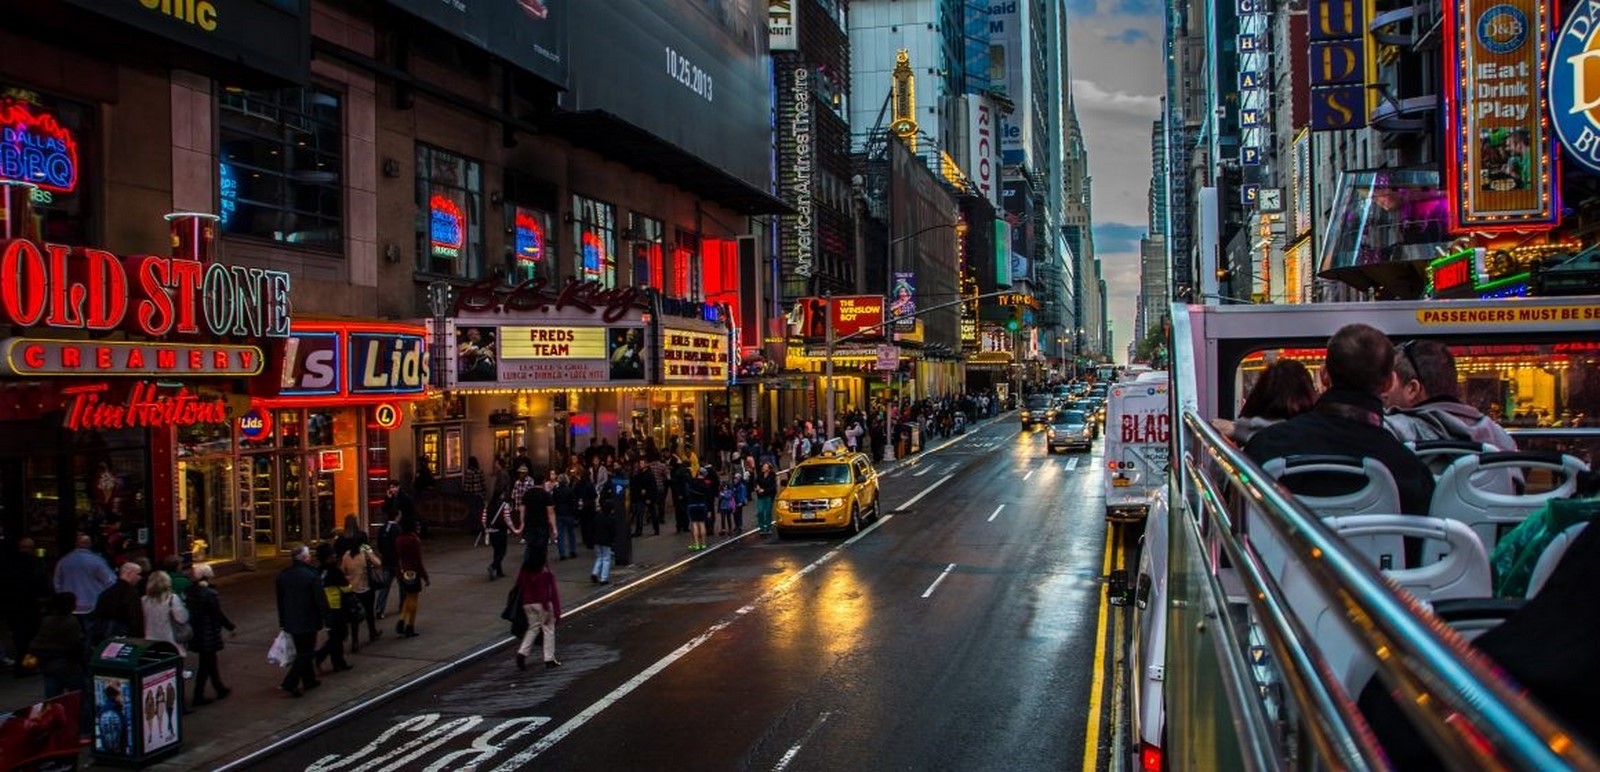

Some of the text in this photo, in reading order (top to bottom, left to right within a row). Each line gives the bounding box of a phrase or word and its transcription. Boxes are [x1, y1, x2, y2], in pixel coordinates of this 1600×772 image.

[666, 46, 713, 102] 10.25.2013
[1478, 62, 1529, 79] Eat
[1240, 0, 1255, 199] CHAMPS
[1478, 82, 1529, 98] Drink
[1478, 101, 1530, 120] Play
[4, 127, 66, 153] DALLAS
[0, 141, 74, 188] BBQ
[1, 239, 291, 337] OLD STONE
[555, 275, 655, 323] King
[840, 306, 881, 314] WINSLOW
[840, 313, 858, 321] BOY
[1424, 310, 1515, 322] PASSENGERS
[1519, 308, 1557, 320] MUST
[1561, 308, 1580, 319] BE
[530, 329, 574, 342] FREDS
[25, 344, 253, 370] CREAMERY
[533, 344, 569, 356] TEAM
[363, 339, 430, 387] Lids
[63, 380, 227, 431] Tim Hortons
[240, 417, 263, 430] Lids
